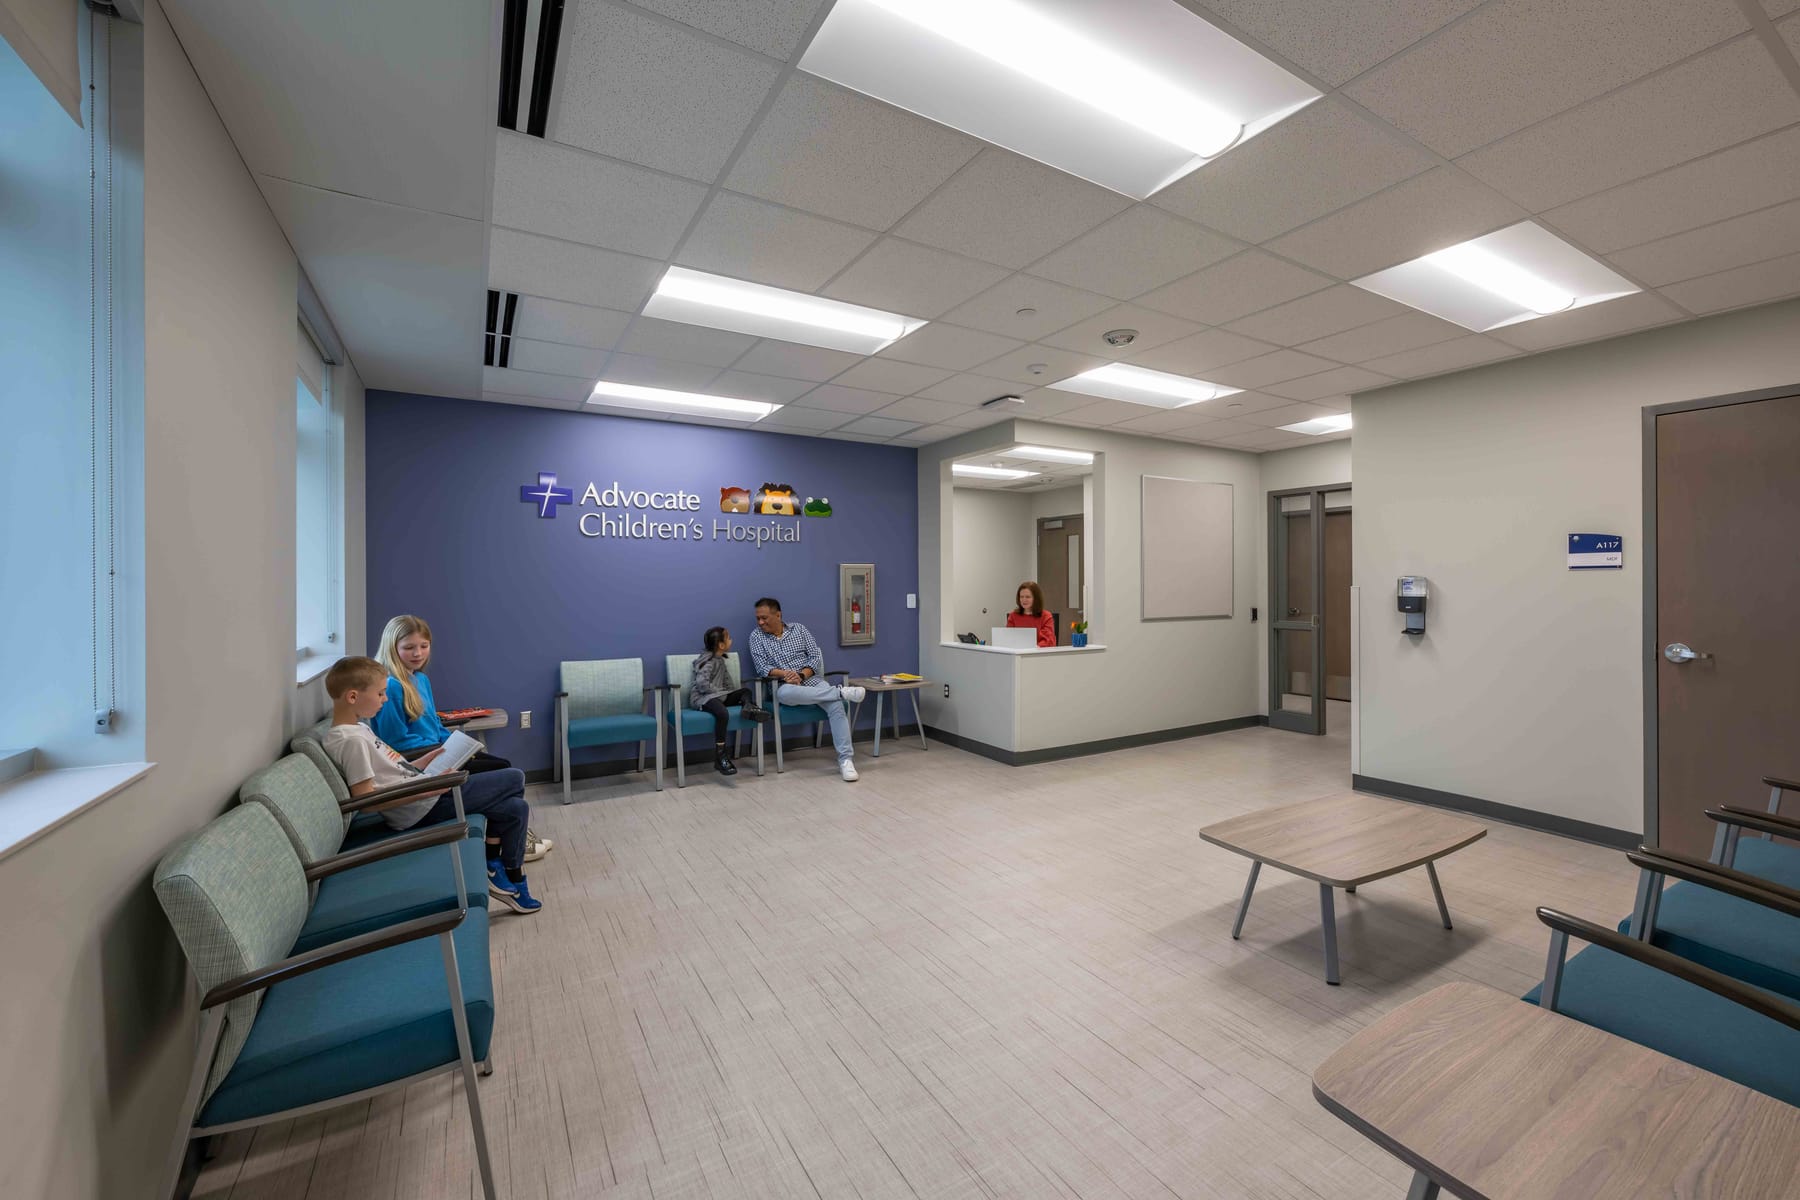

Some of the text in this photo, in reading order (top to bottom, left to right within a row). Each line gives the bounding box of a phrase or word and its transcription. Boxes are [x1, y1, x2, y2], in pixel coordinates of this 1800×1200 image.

[579, 481, 700, 511] Advocate
[579, 513, 801, 549] Children's Hospital
[1596, 541, 1619, 549] A117
